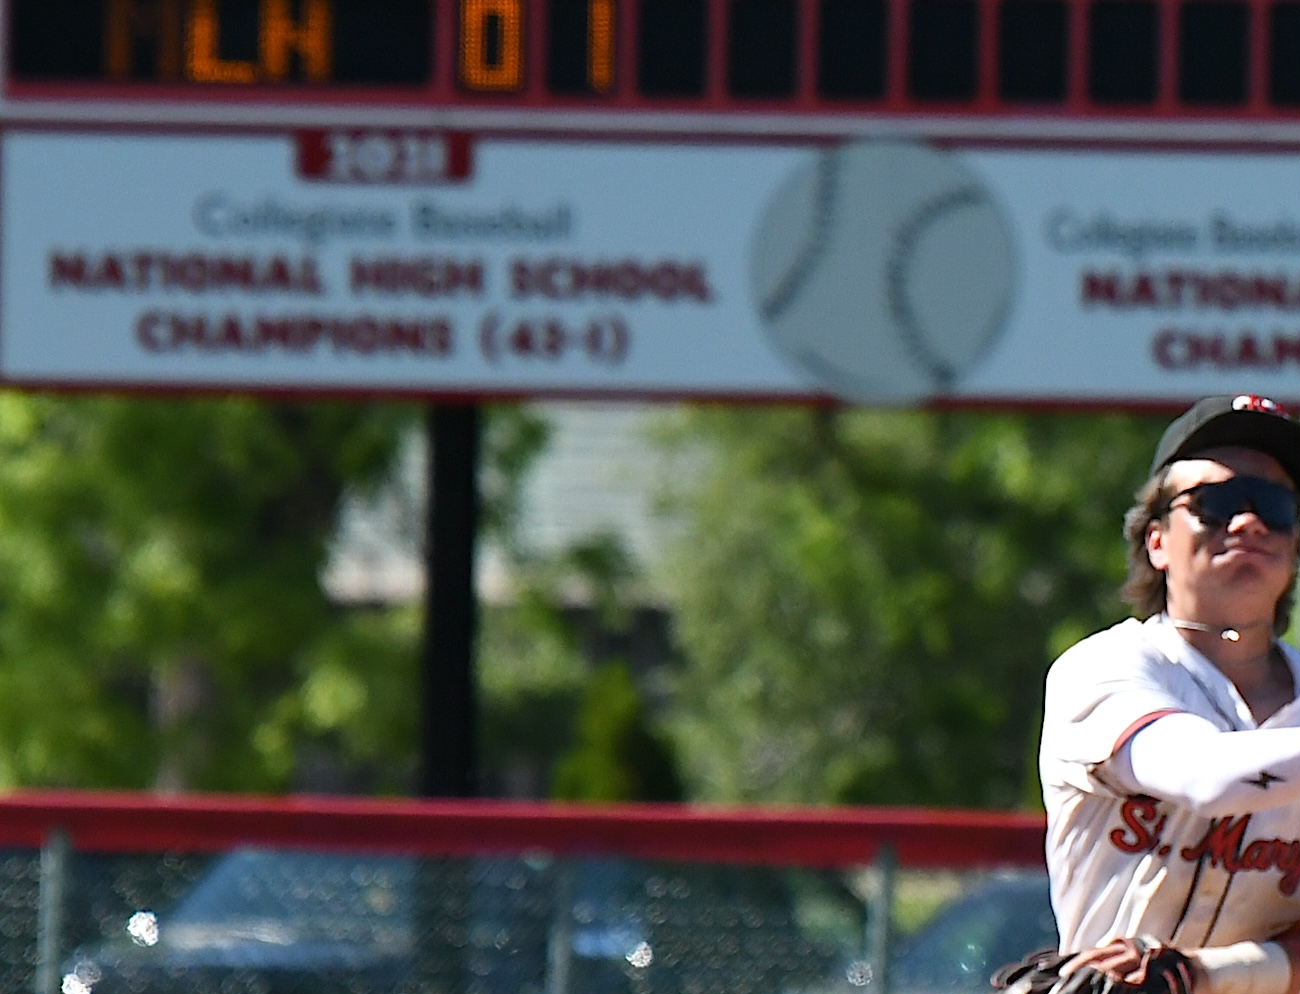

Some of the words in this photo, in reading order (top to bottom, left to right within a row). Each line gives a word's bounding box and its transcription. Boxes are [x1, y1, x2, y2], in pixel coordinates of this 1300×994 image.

[409, 200, 572, 243] Baseball
[49, 252, 324, 297] NATIONAL
[349, 254, 486, 300] HIGH
[508, 256, 714, 306] SCHOOL
[134, 310, 454, 357] CHAMPIONS
